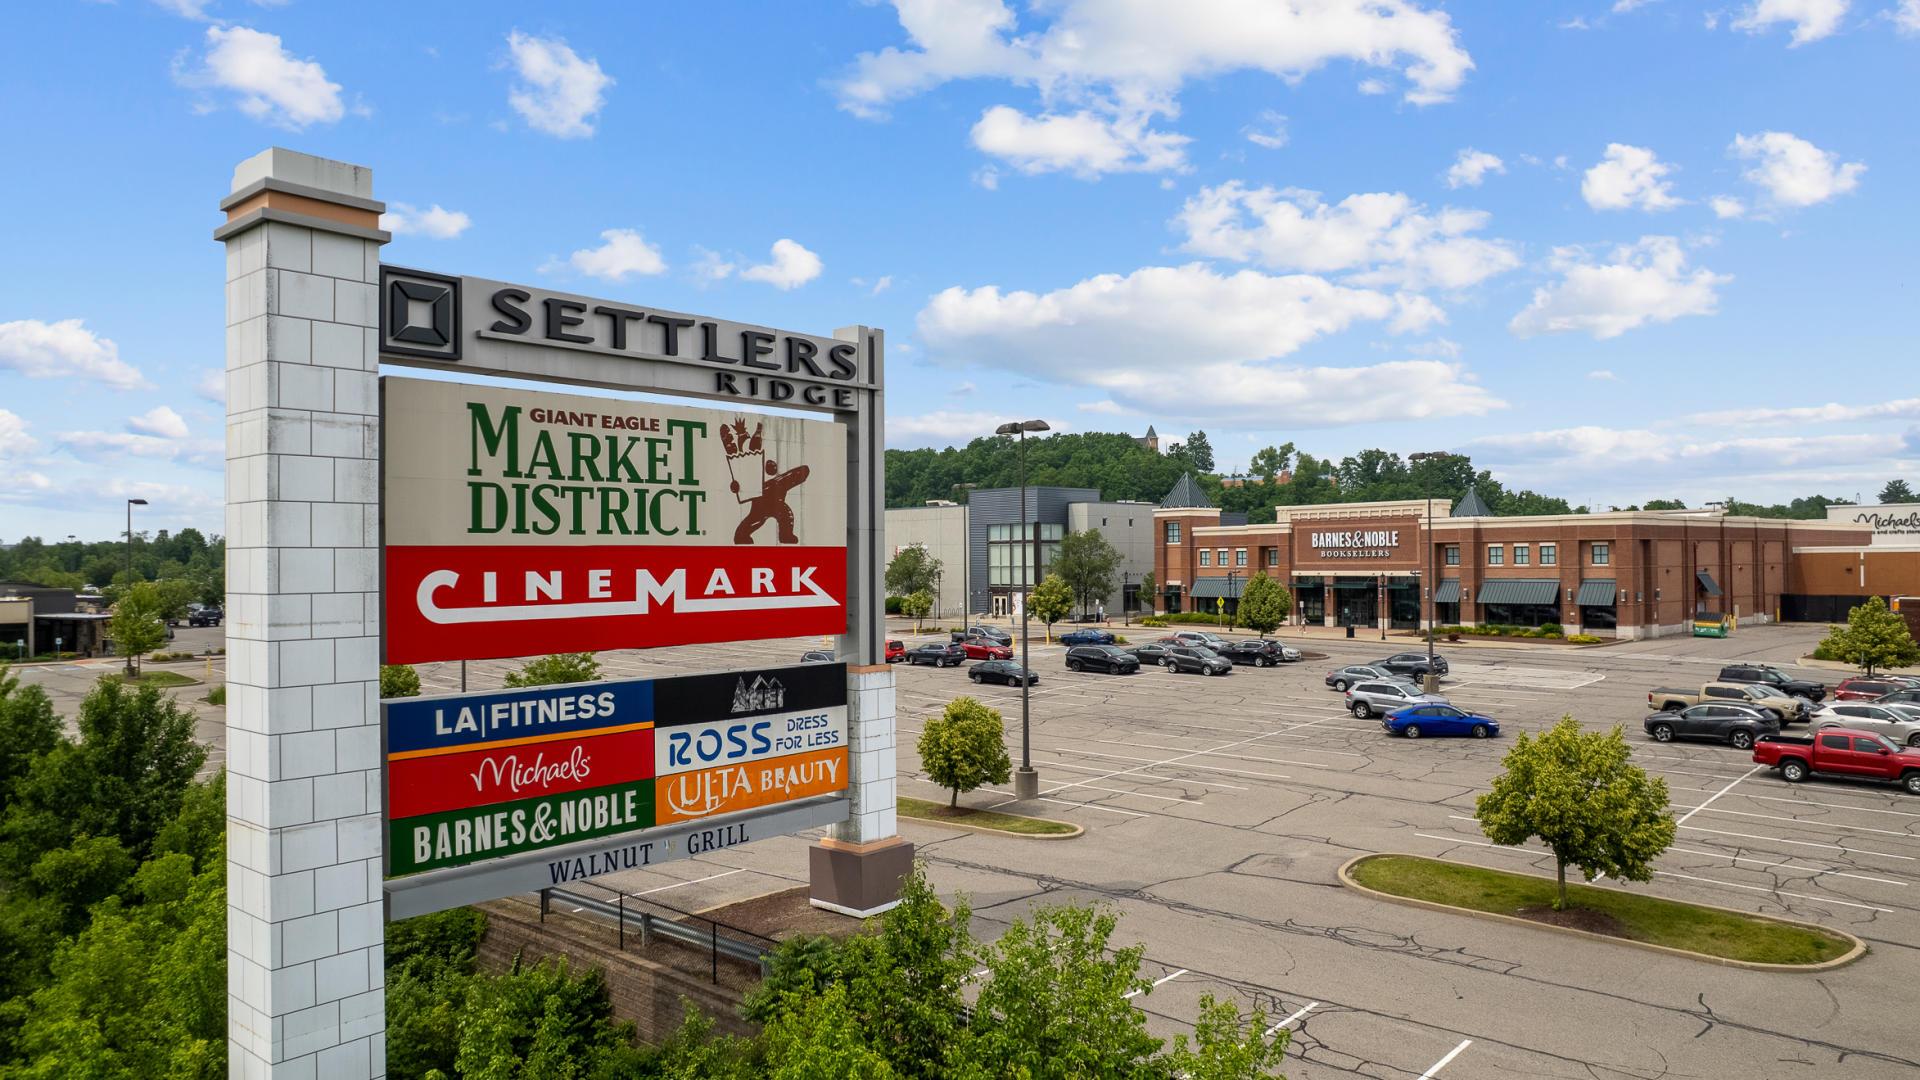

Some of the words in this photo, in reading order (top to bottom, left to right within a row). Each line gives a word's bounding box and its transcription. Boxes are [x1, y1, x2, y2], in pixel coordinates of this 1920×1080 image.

[490, 288, 857, 381] SETTLERS
[715, 371, 855, 407] RIDGE
[467, 402, 707, 486] MARKET
[530, 408, 597, 428] GIANT
[601, 415, 660, 432] EAGLE
[467, 481, 706, 536] DISTRICT
[1852, 511, 1920, 529] Michaels
[416, 566, 841, 624] CINEMARK
[669, 721, 772, 767] ROSS
[776, 736, 802, 752] FOR
[808, 730, 839, 747] LESS
[787, 714, 828, 732] DRESS
[470, 745, 591, 793] Michaels
[670, 766, 752, 814] ULTA
[761, 757, 840, 794] BEAUTY
[549, 843, 653, 884] WALNUT
[687, 823, 750, 854] GRILL
